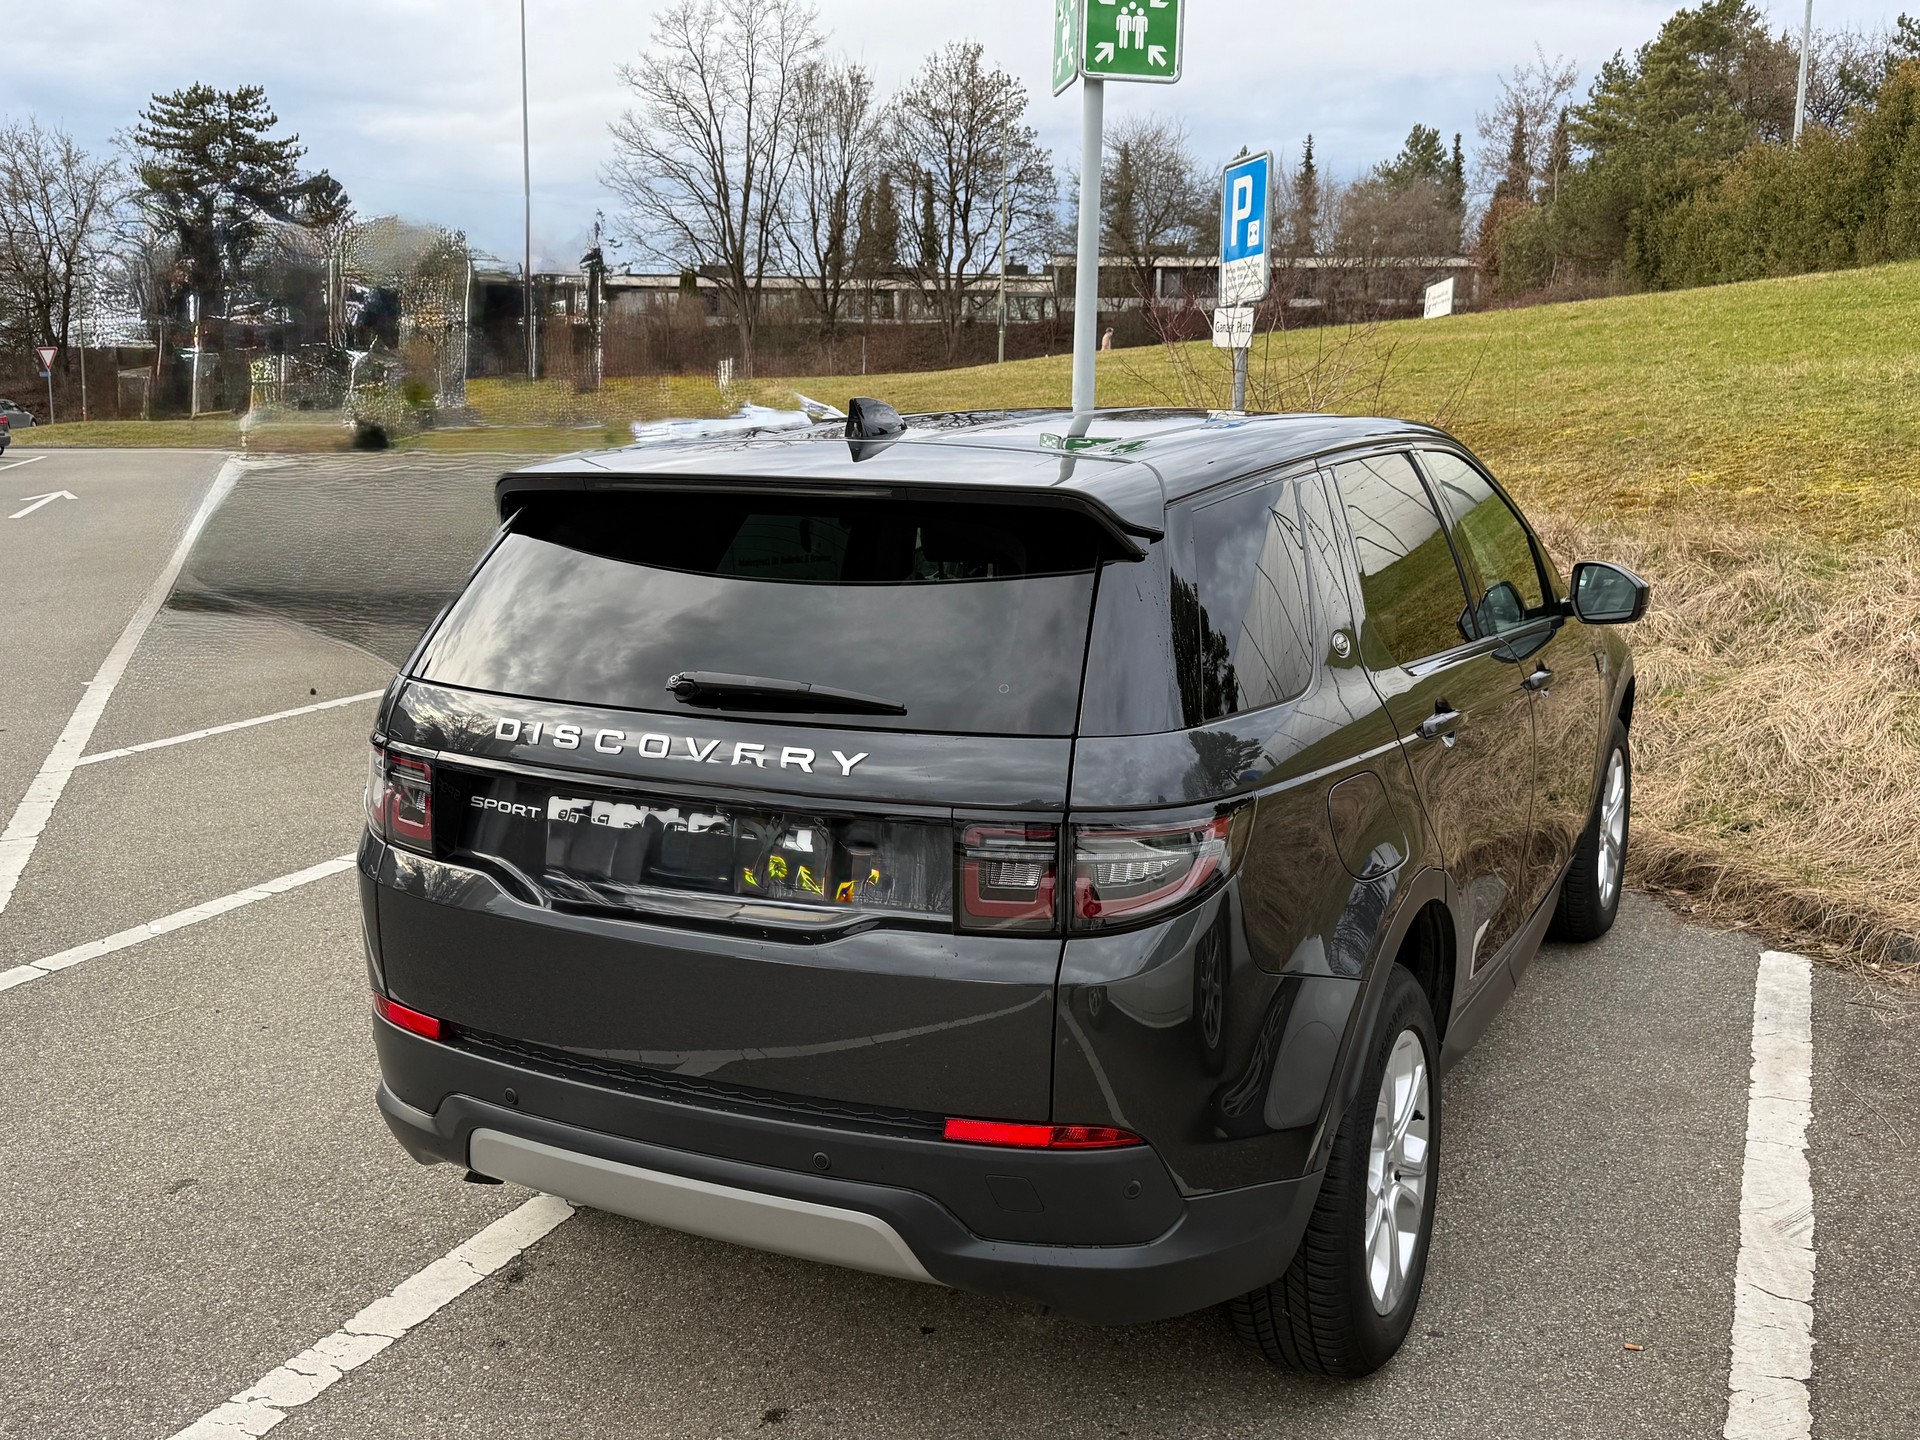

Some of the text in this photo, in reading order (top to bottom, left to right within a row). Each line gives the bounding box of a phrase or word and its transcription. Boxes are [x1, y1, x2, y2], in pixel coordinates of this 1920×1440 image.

[1230, 174, 1253, 247] P
[1236, 321, 1252, 333] Platz
[470, 795, 542, 819] SPORT
